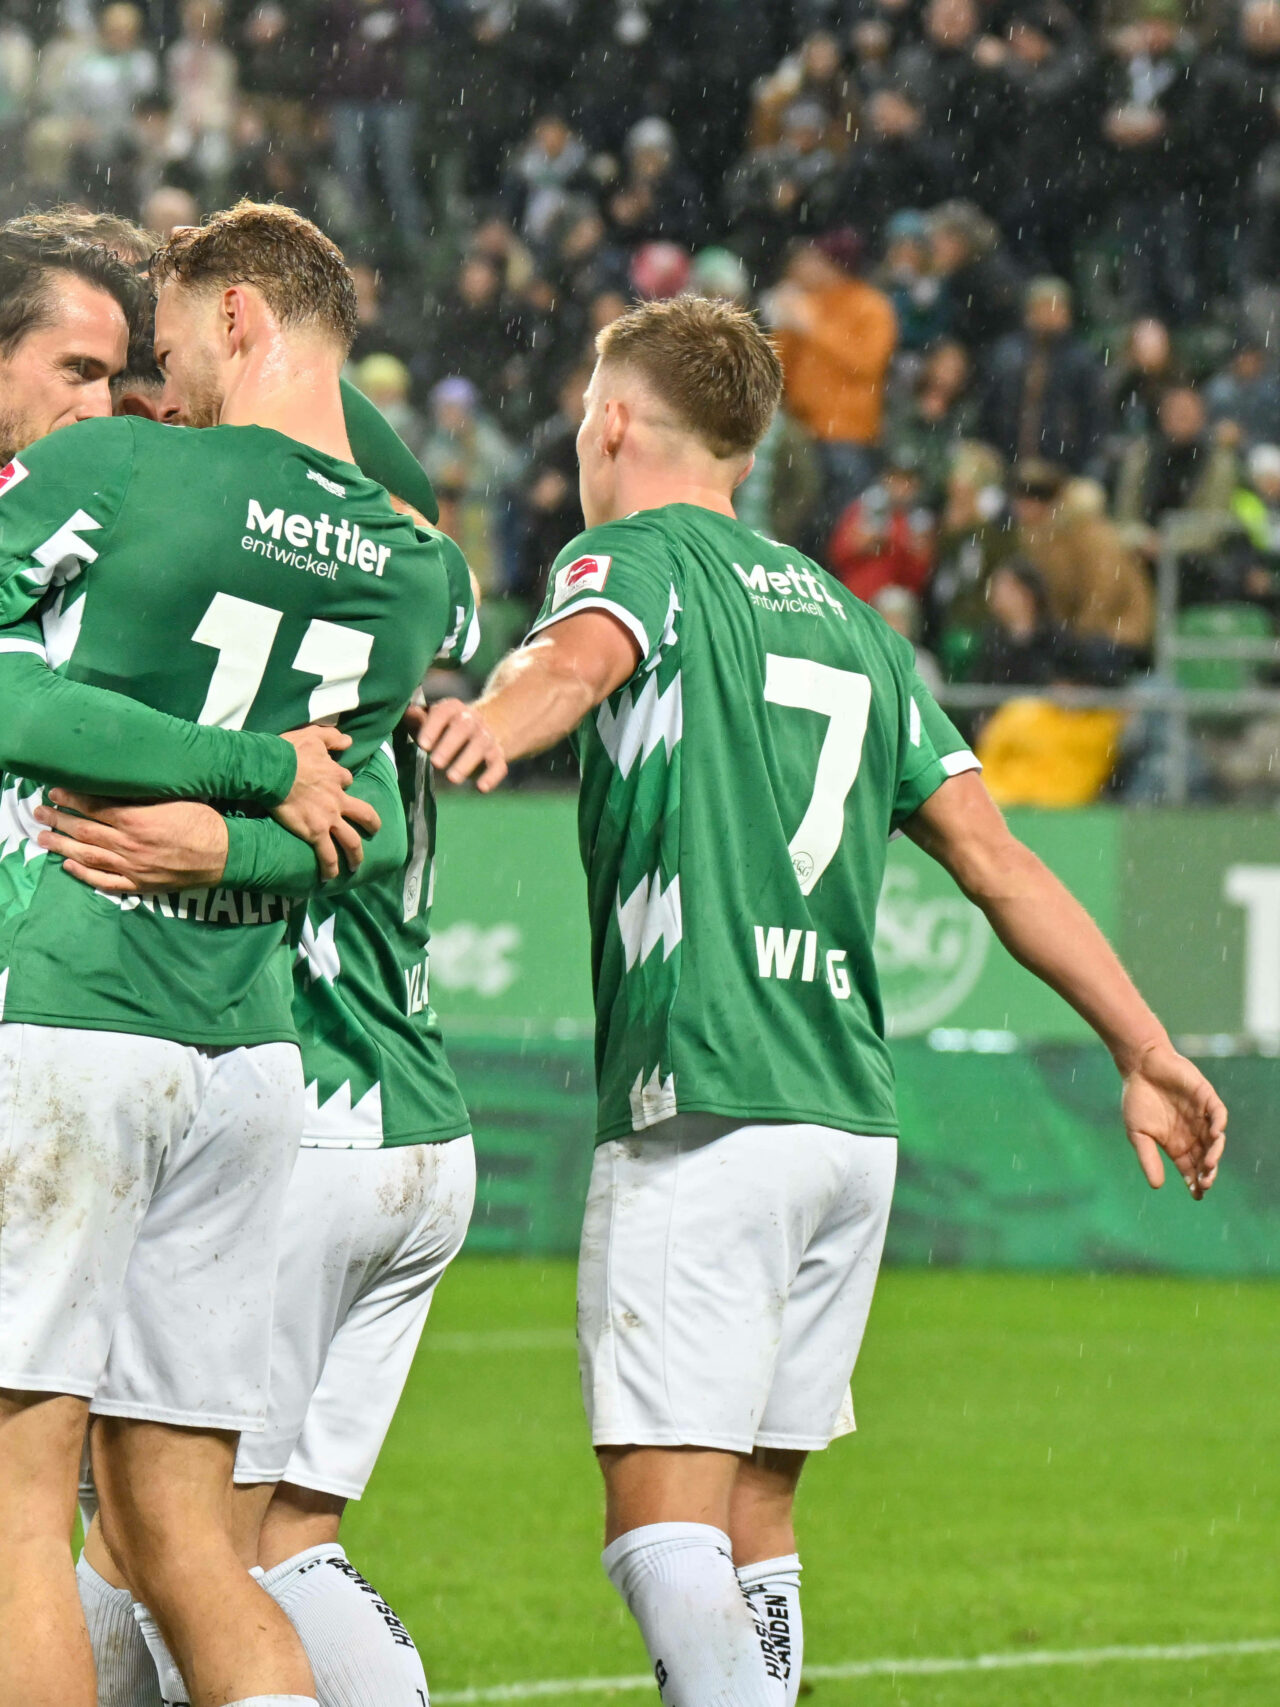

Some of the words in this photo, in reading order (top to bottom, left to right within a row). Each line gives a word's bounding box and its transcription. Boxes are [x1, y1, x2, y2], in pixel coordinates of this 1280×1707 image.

[241, 535, 339, 581] entwickelt
[246, 498, 391, 577] Mettler
[192, 591, 375, 729] 11
[764, 652, 871, 896] 7
